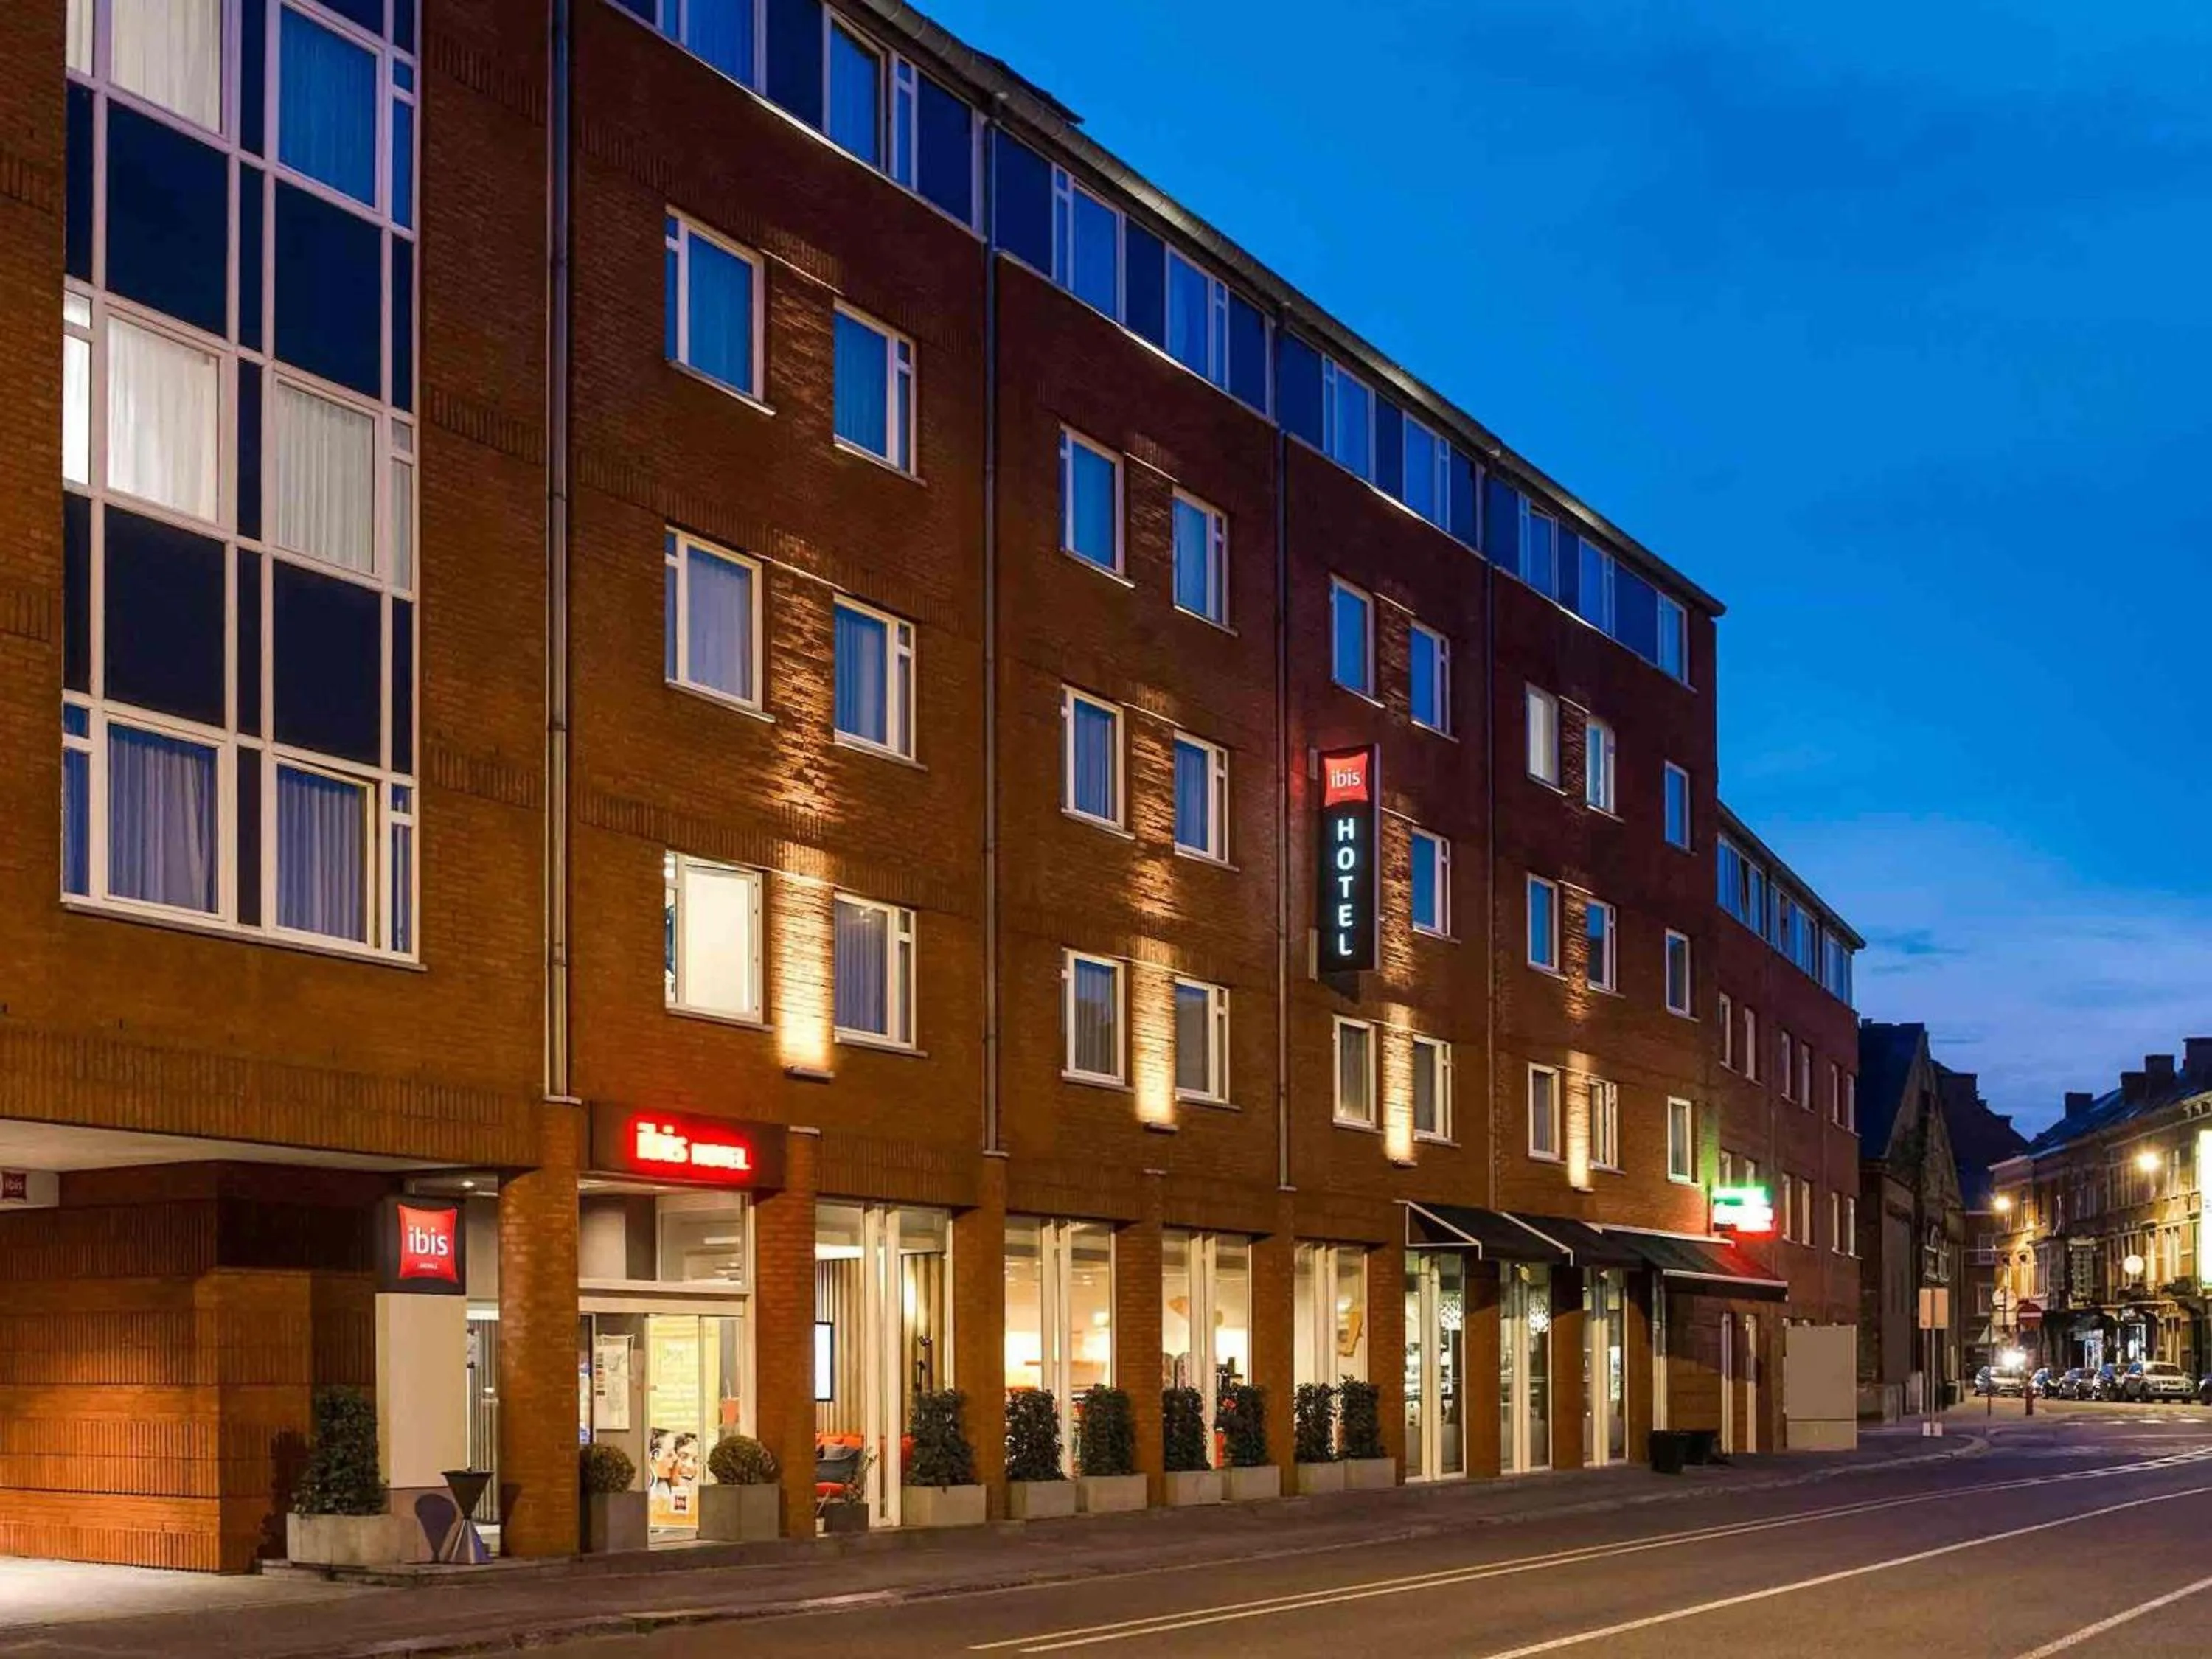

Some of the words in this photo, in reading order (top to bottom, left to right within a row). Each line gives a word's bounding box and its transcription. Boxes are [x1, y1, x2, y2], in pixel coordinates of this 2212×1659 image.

[1330, 768, 1360, 788] ibis
[1336, 818, 1356, 956] HOTEL
[408, 1226, 448, 1256] ibis
